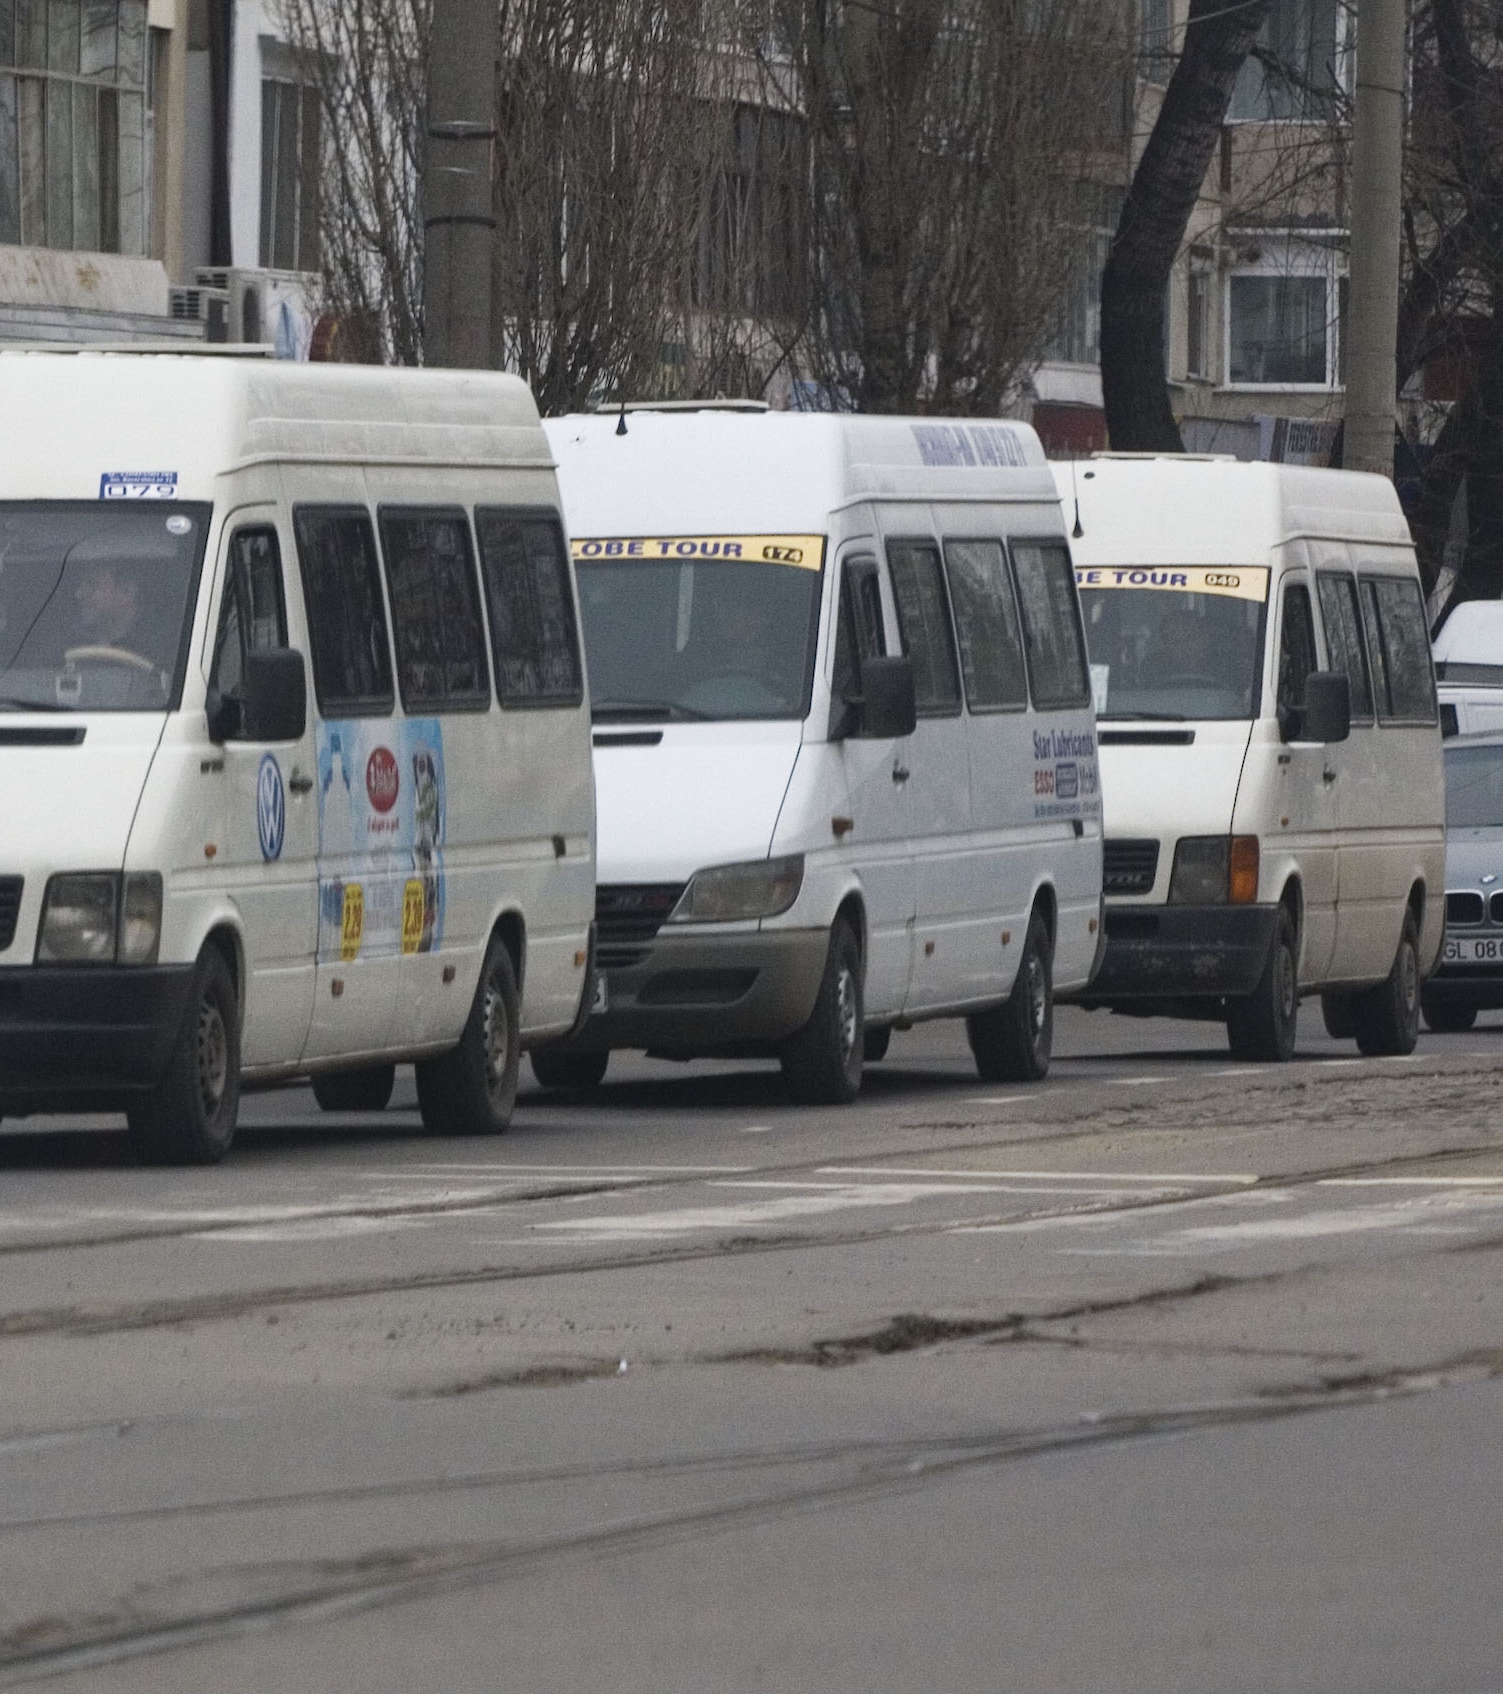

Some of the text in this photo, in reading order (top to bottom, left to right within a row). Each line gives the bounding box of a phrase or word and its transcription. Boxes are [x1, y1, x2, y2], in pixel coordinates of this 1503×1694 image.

[107, 484, 175, 498] 079
[656, 541, 743, 558] TOUR
[1111, 571, 1188, 587] TOUR
[1444, 942, 1467, 959] GL
